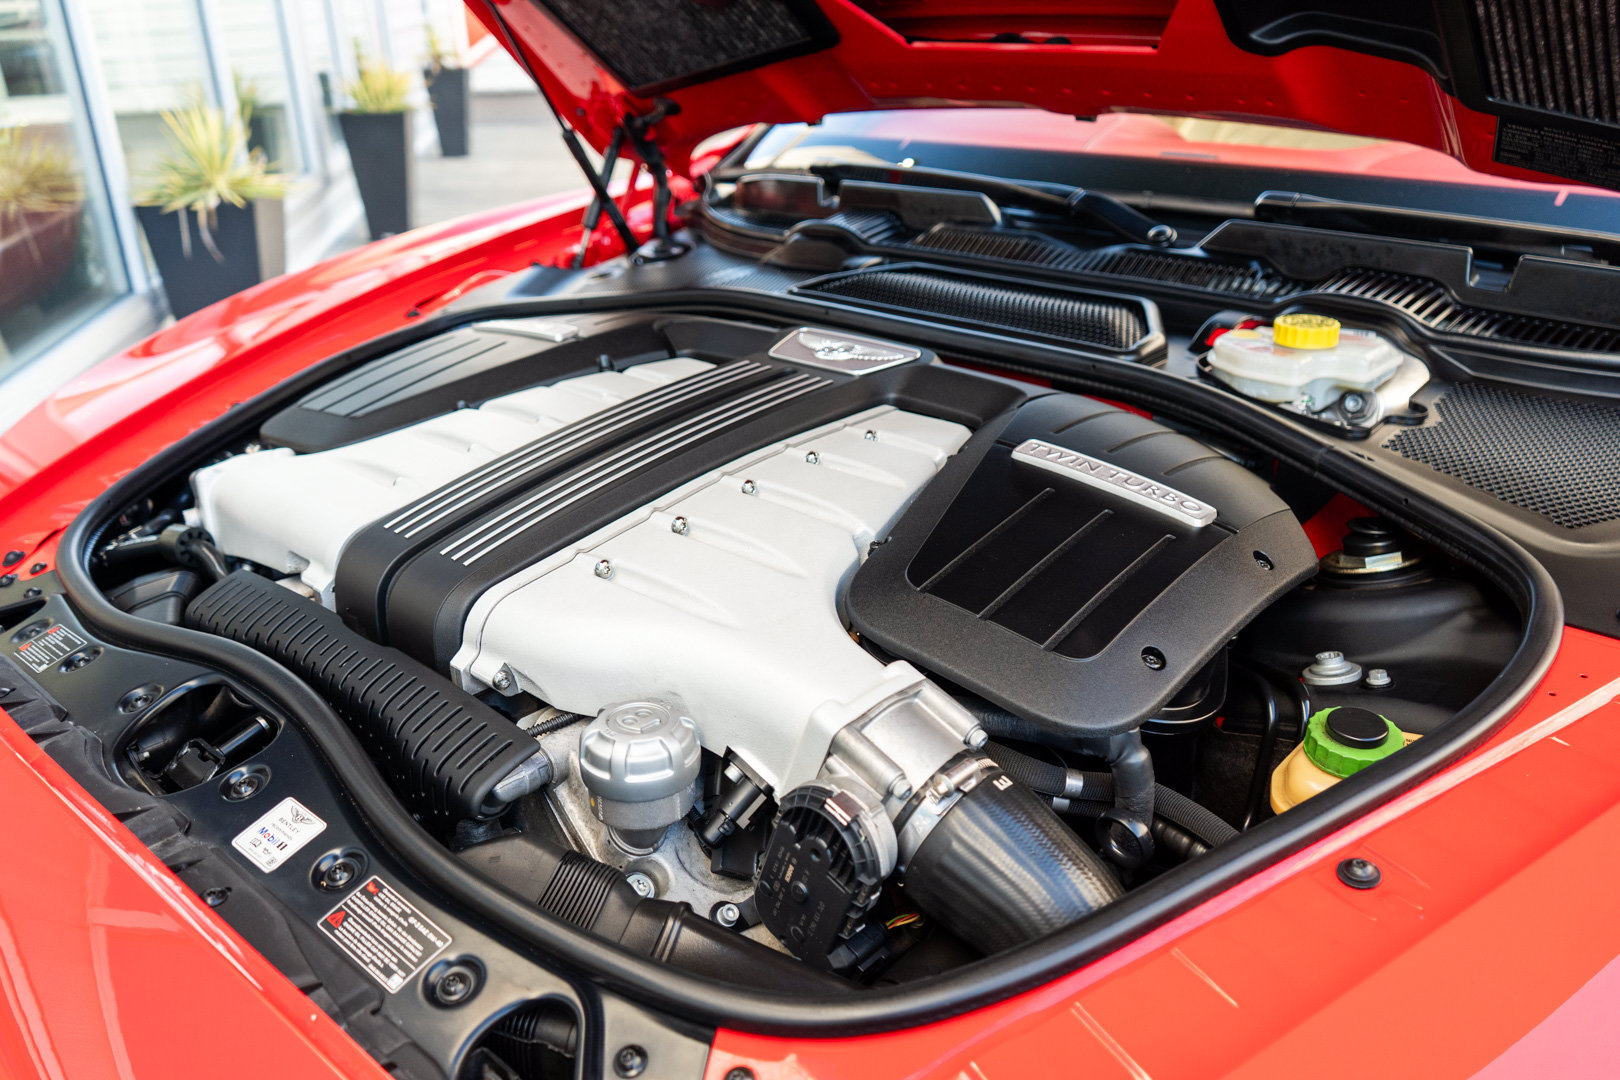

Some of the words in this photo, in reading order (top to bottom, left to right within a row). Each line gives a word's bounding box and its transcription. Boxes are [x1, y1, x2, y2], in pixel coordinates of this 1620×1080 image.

[1030, 443, 1099, 473] TWIN
[1109, 470, 1202, 513] TURBO
[258, 826, 280, 846] Mobil
